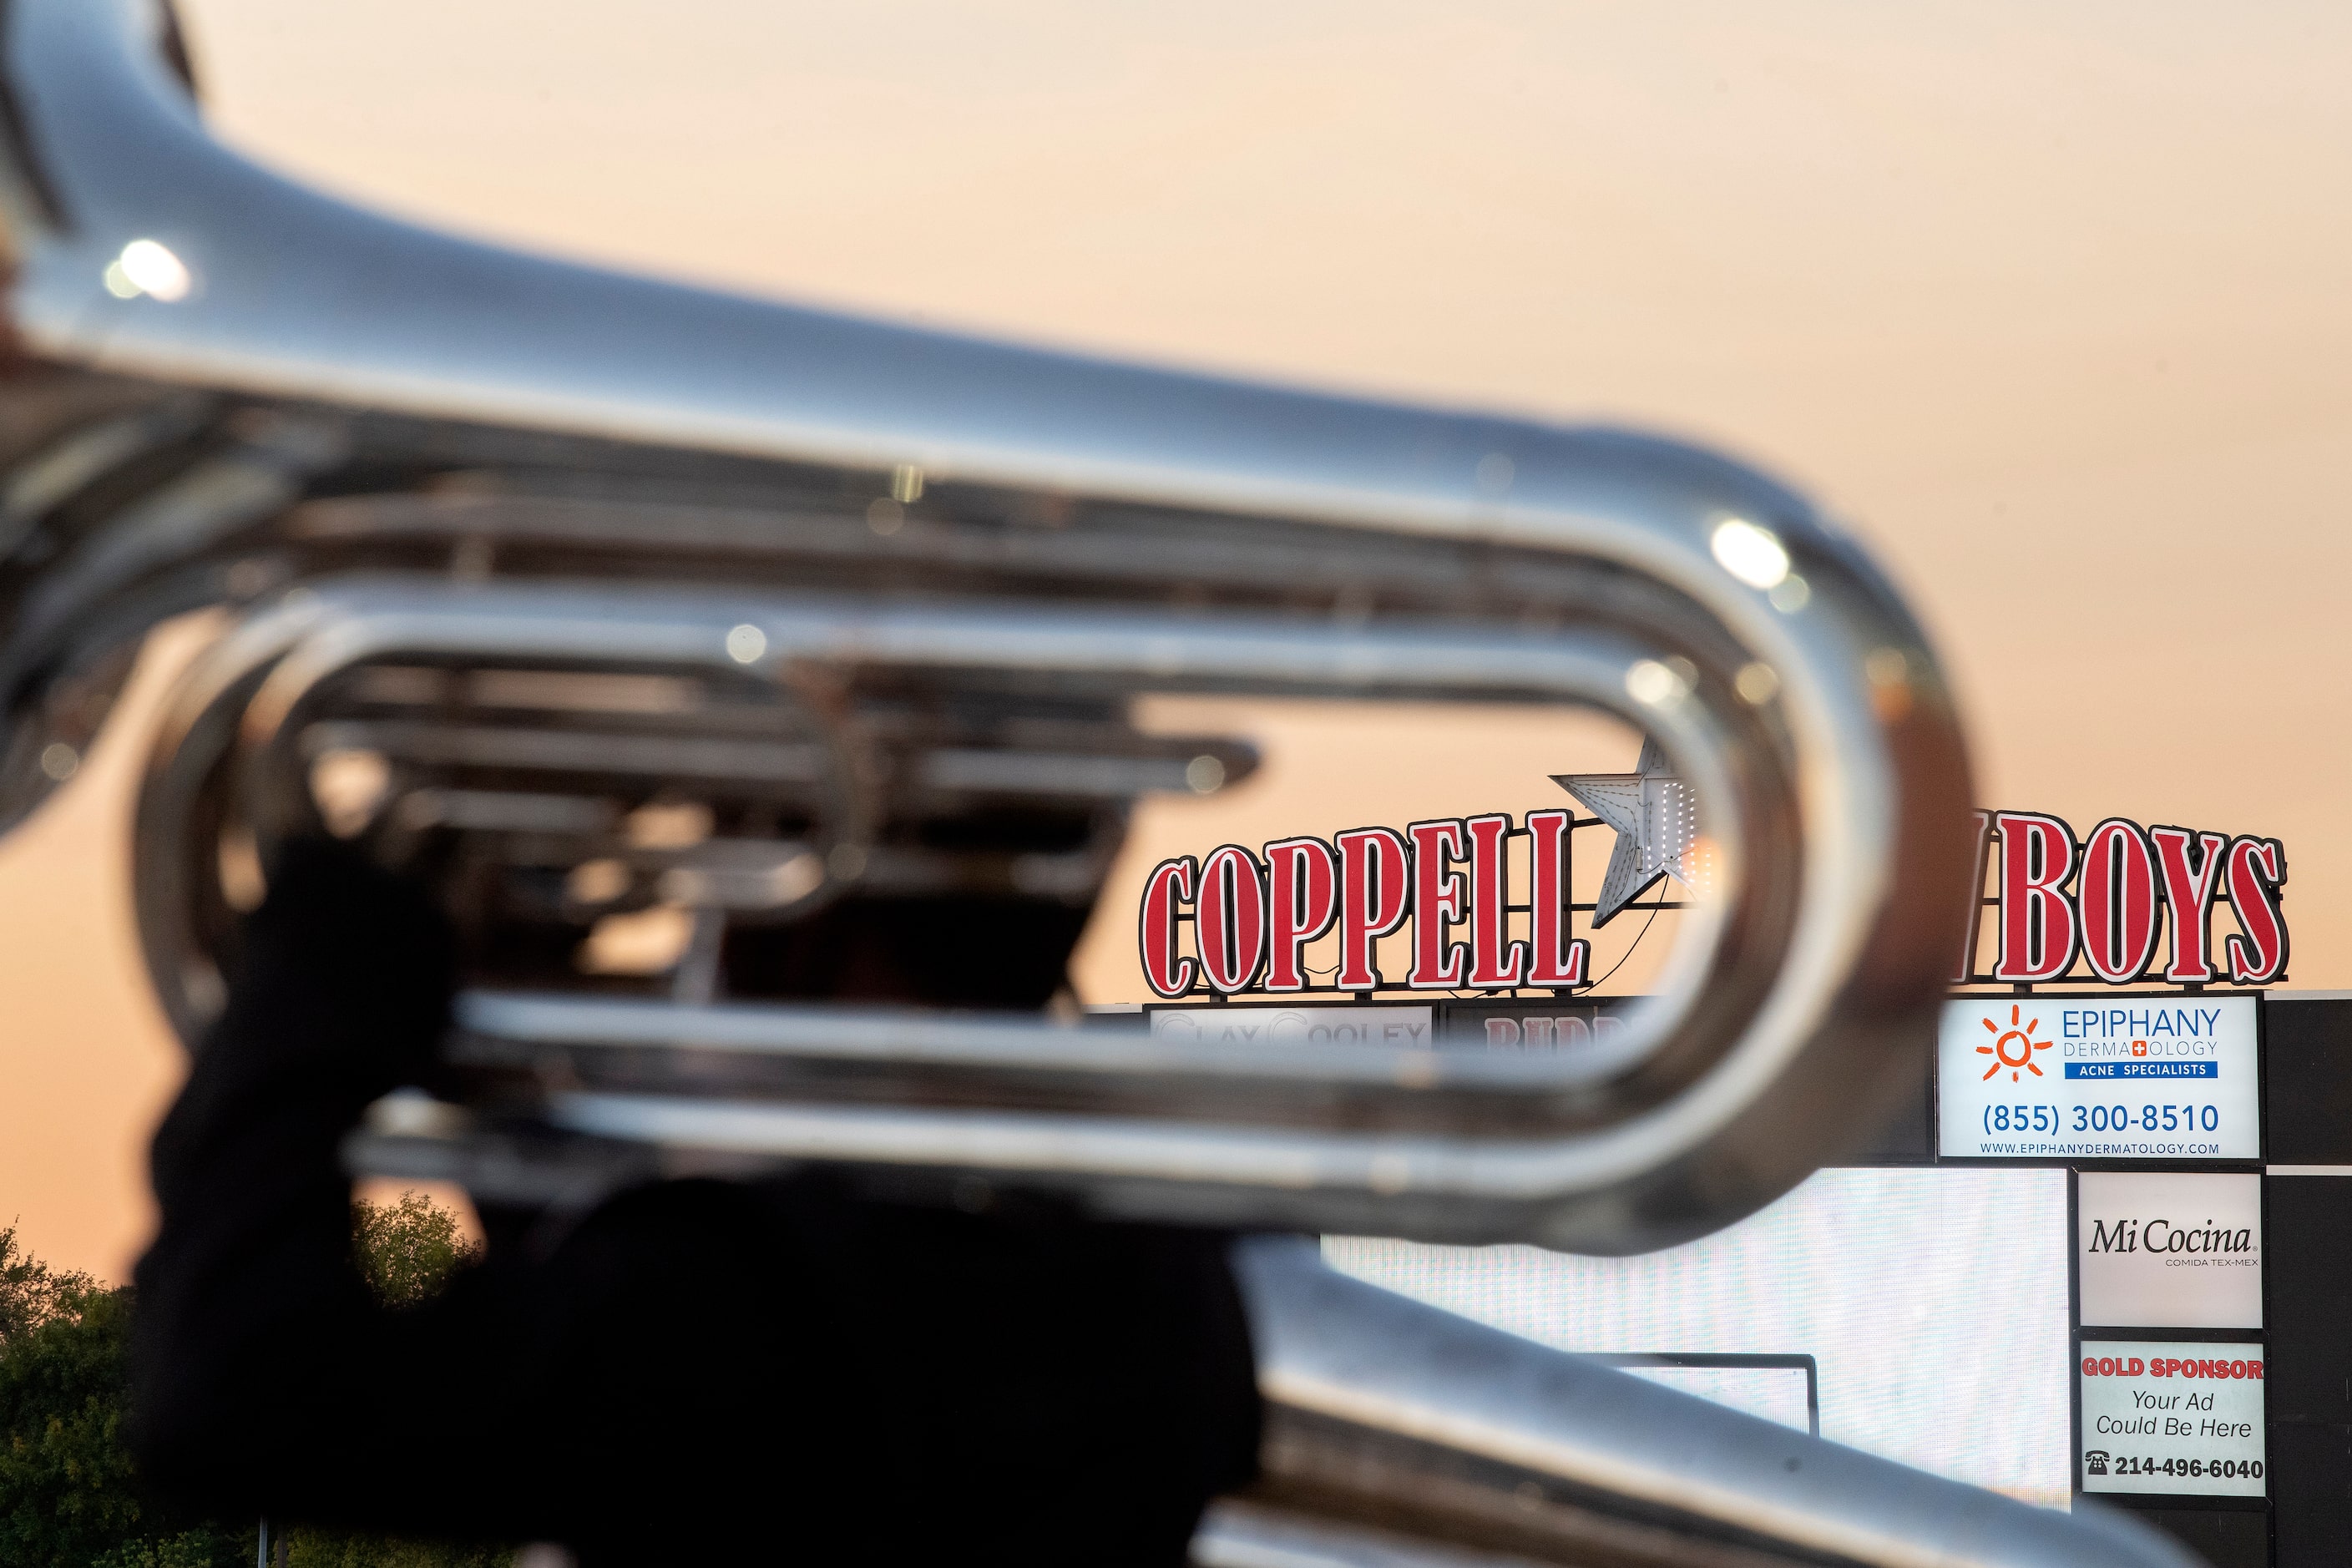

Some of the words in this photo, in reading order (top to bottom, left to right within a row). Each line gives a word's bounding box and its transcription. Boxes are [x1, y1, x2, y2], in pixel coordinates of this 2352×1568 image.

[1139, 808, 1591, 999] COPPELL
[1950, 809, 2289, 984] BOYS
[2063, 1009, 2221, 1038] EPIPHANY
[2079, 1065, 2115, 1076] ACNE
[2123, 1064, 2207, 1076] SPECIALISTS
[1983, 1105, 2060, 1136] (855)
[2071, 1104, 2219, 1132] 300-8510
[1980, 1142, 2220, 1155] WWW.EPIPHANYDERMATOLOGY.COM
[2088, 1219, 2137, 1253] Mi
[2165, 1259, 2209, 1267] COMIDA
[2211, 1259, 2258, 1267] TEX-MEX
[2081, 1357, 2145, 1378] GOLD
[2149, 1358, 2264, 1380] SPONSOR
[2132, 1390, 2180, 1412] Your
[2185, 1392, 2214, 1412] Ad
[2097, 1414, 2157, 1436] Could
[2165, 1417, 2193, 1437] Be
[2200, 1418, 2253, 1439] Here
[2115, 1456, 2264, 1479] 214-496-6040
